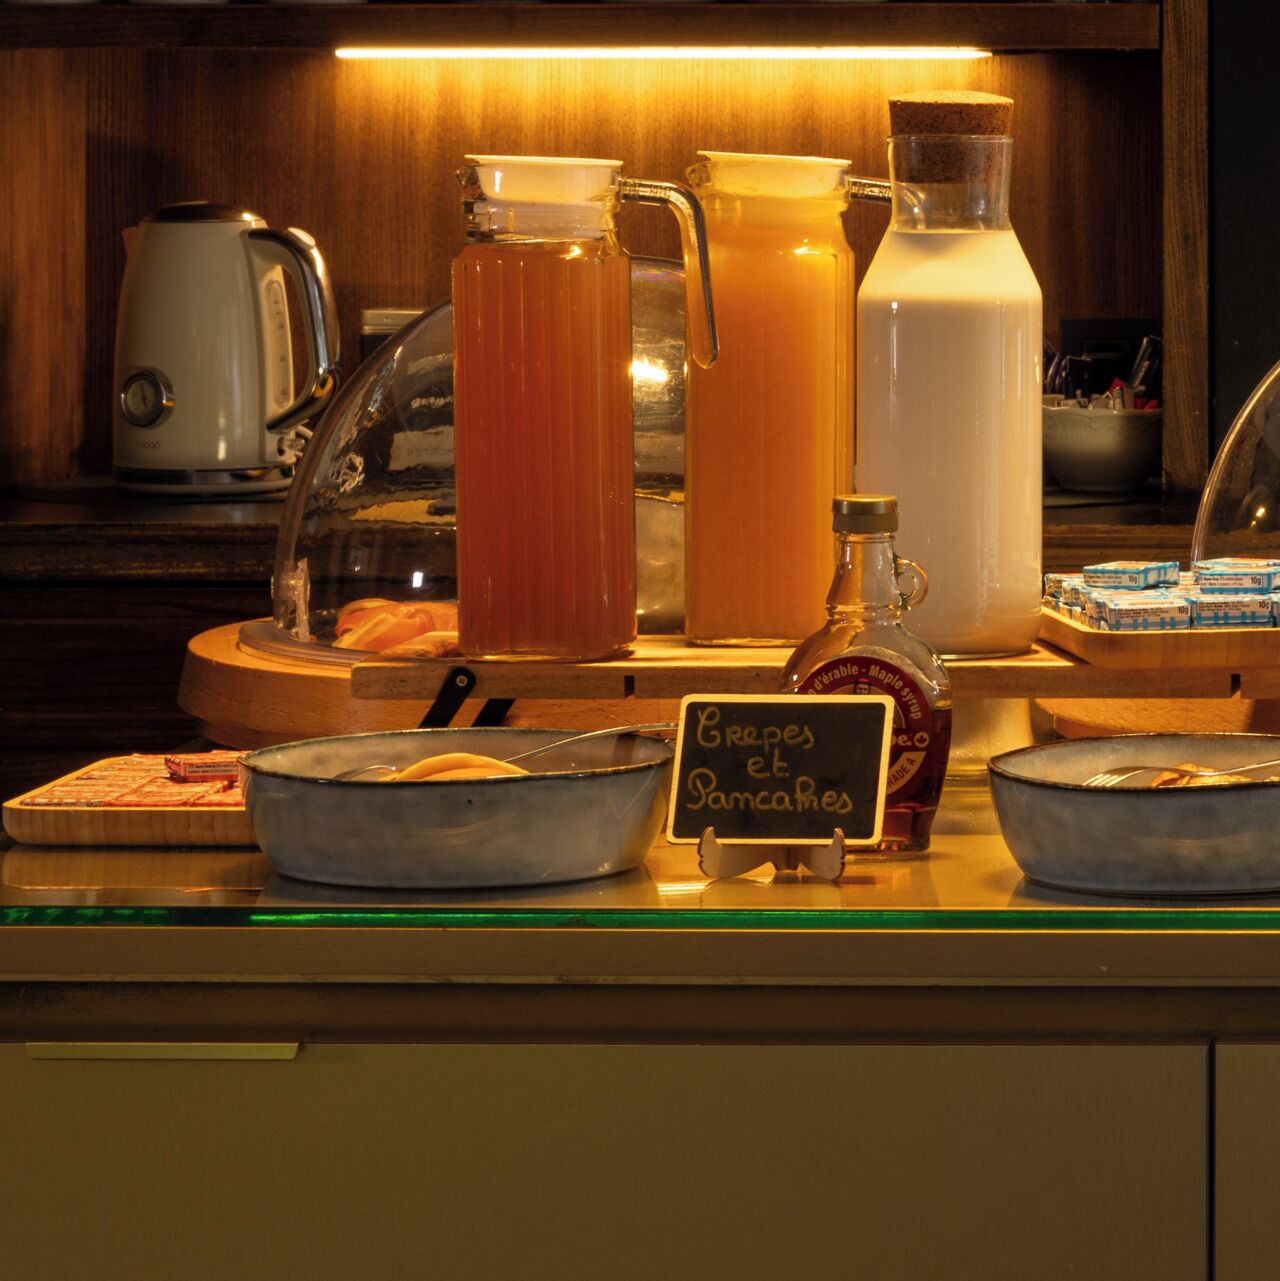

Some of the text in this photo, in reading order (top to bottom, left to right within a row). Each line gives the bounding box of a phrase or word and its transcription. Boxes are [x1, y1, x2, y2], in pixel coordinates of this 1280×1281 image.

[1250, 576, 1262, 586] 10g
[1178, 606, 1189, 616] 10g
[1258, 600, 1270, 610] 10g
[814, 663, 859, 690] d'érable
[869, 665, 903, 689] Maple
[901, 687, 922, 720] syrup
[746, 747, 790, 779] et
[887, 763, 910, 787] RADE
